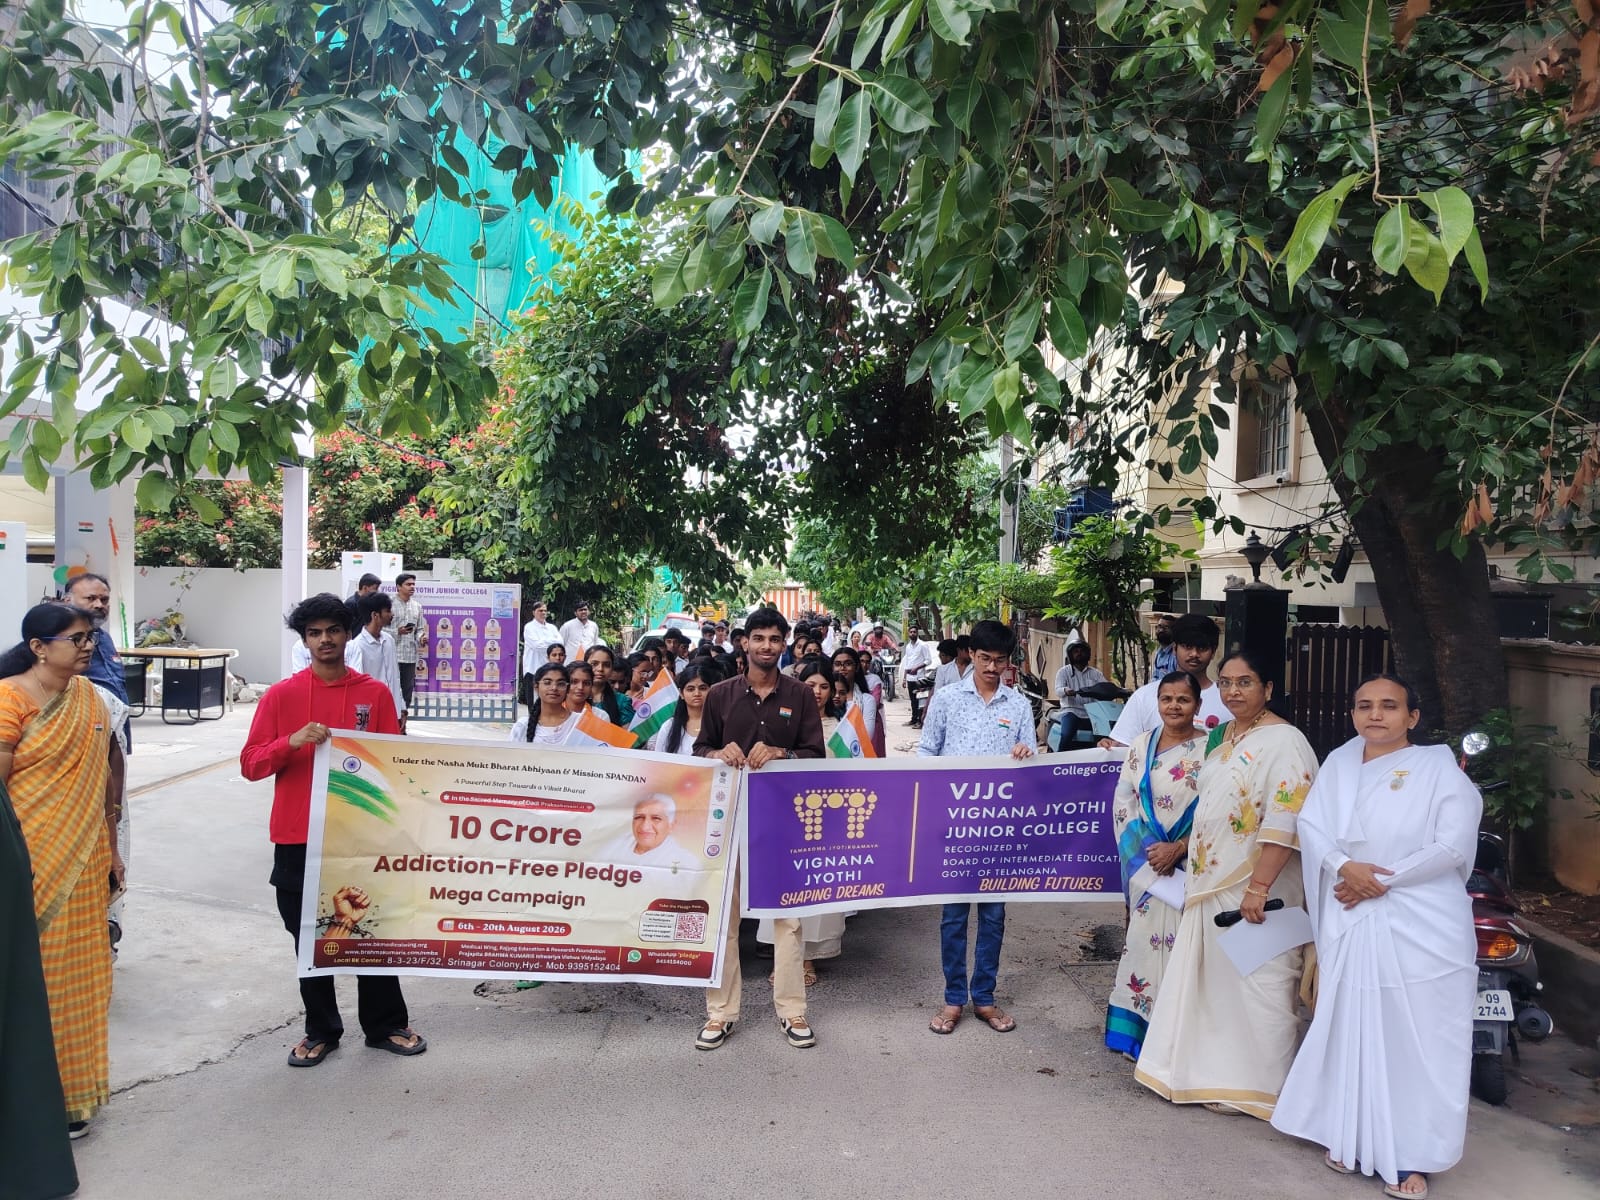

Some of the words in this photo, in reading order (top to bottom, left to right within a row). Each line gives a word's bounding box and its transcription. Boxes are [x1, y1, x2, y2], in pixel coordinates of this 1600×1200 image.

[392, 756, 419, 765] Under
[421, 758, 435, 766] the
[437, 759, 465, 768] Nasha
[466, 761, 489, 769] Mukt
[490, 762, 520, 771] Bharat
[521, 765, 561, 776] Abhiyaan
[572, 769, 604, 779] Mission
[605, 772, 647, 783] SPANDAN
[1053, 765, 1097, 777] College
[460, 779, 491, 787] Powerful
[492, 780, 507, 788] Step
[563, 786, 586, 794] Bharat
[950, 782, 1014, 800] VJJC
[948, 806, 1037, 819] VIGNANA
[1043, 801, 1106, 816] JYOTHI
[449, 815, 481, 840] 10
[490, 818, 582, 847] Crore
[945, 825, 1015, 839] JUNIOR
[1022, 821, 1100, 837] COLLEGE
[944, 844, 1013, 854] RECOGNIZED
[1016, 843, 1029, 851] BY
[793, 854, 875, 871] VIGNANA
[943, 857, 979, 866] BOARD
[982, 857, 996, 865] OF
[1000, 854, 1073, 864] INTERMEDIATE
[373, 854, 559, 879] Addiction-Free
[564, 861, 643, 888] Pledge
[804, 870, 862, 886] JYOTHI
[941, 869, 974, 878] GOVT.
[977, 869, 991, 877] OF
[995, 867, 1057, 876] TELANGANA
[979, 877, 1040, 891] BUILDING
[1044, 877, 1104, 891] FUTURES
[429, 886, 483, 906] Mega
[487, 888, 586, 910] Campaign
[780, 887, 832, 906] SHAPING
[836, 882, 885, 899] DREAMS
[458, 922, 474, 930] 6th
[483, 923, 505, 932] 20th
[506, 924, 541, 934] August
[542, 925, 566, 934] 2026
[448, 958, 486, 968] Srinagar
[1485, 993, 1500, 1004] 09
[1478, 1006, 1507, 1017] 2744
